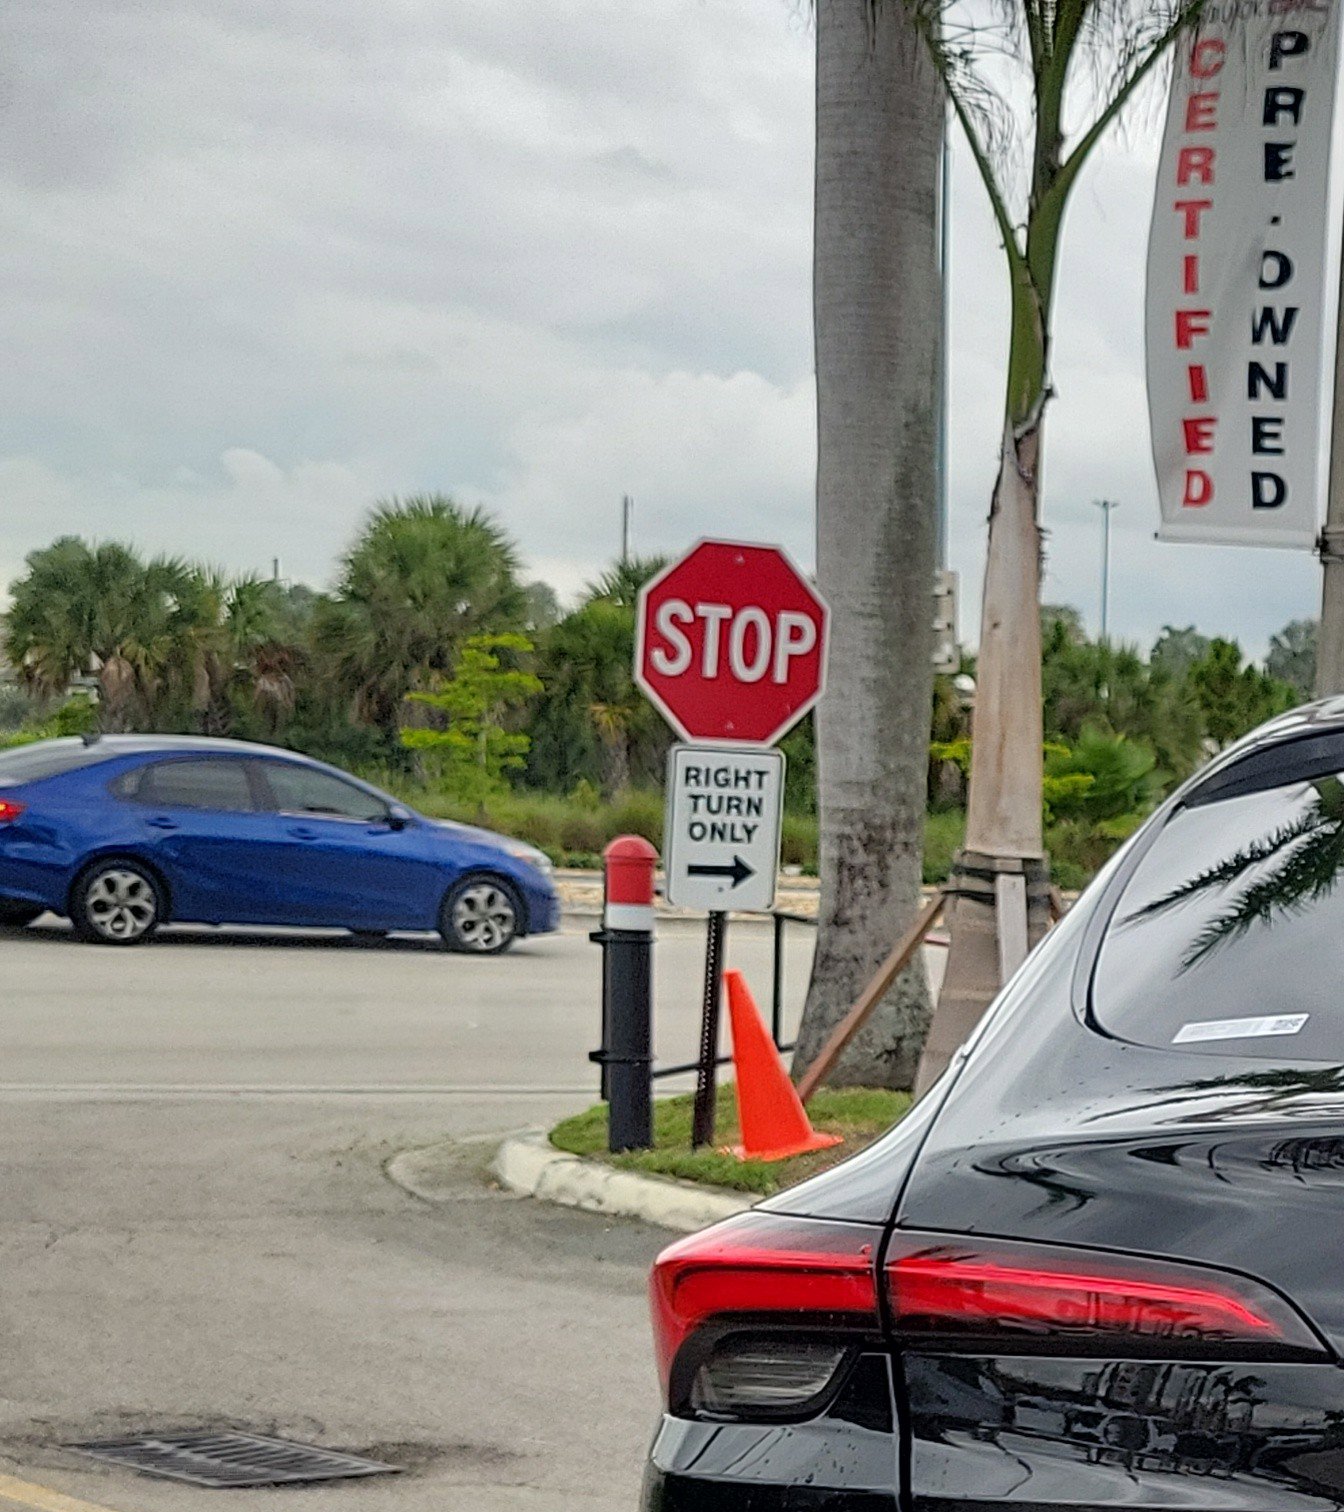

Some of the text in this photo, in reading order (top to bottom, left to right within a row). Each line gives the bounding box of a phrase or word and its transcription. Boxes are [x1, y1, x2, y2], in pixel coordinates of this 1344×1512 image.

[1174, 37, 1227, 509] CERTIFIED
[650, 598, 817, 684] STOP
[684, 765, 770, 791] RIGHT
[688, 794, 763, 818] TURN
[688, 822, 759, 844] ONLY
